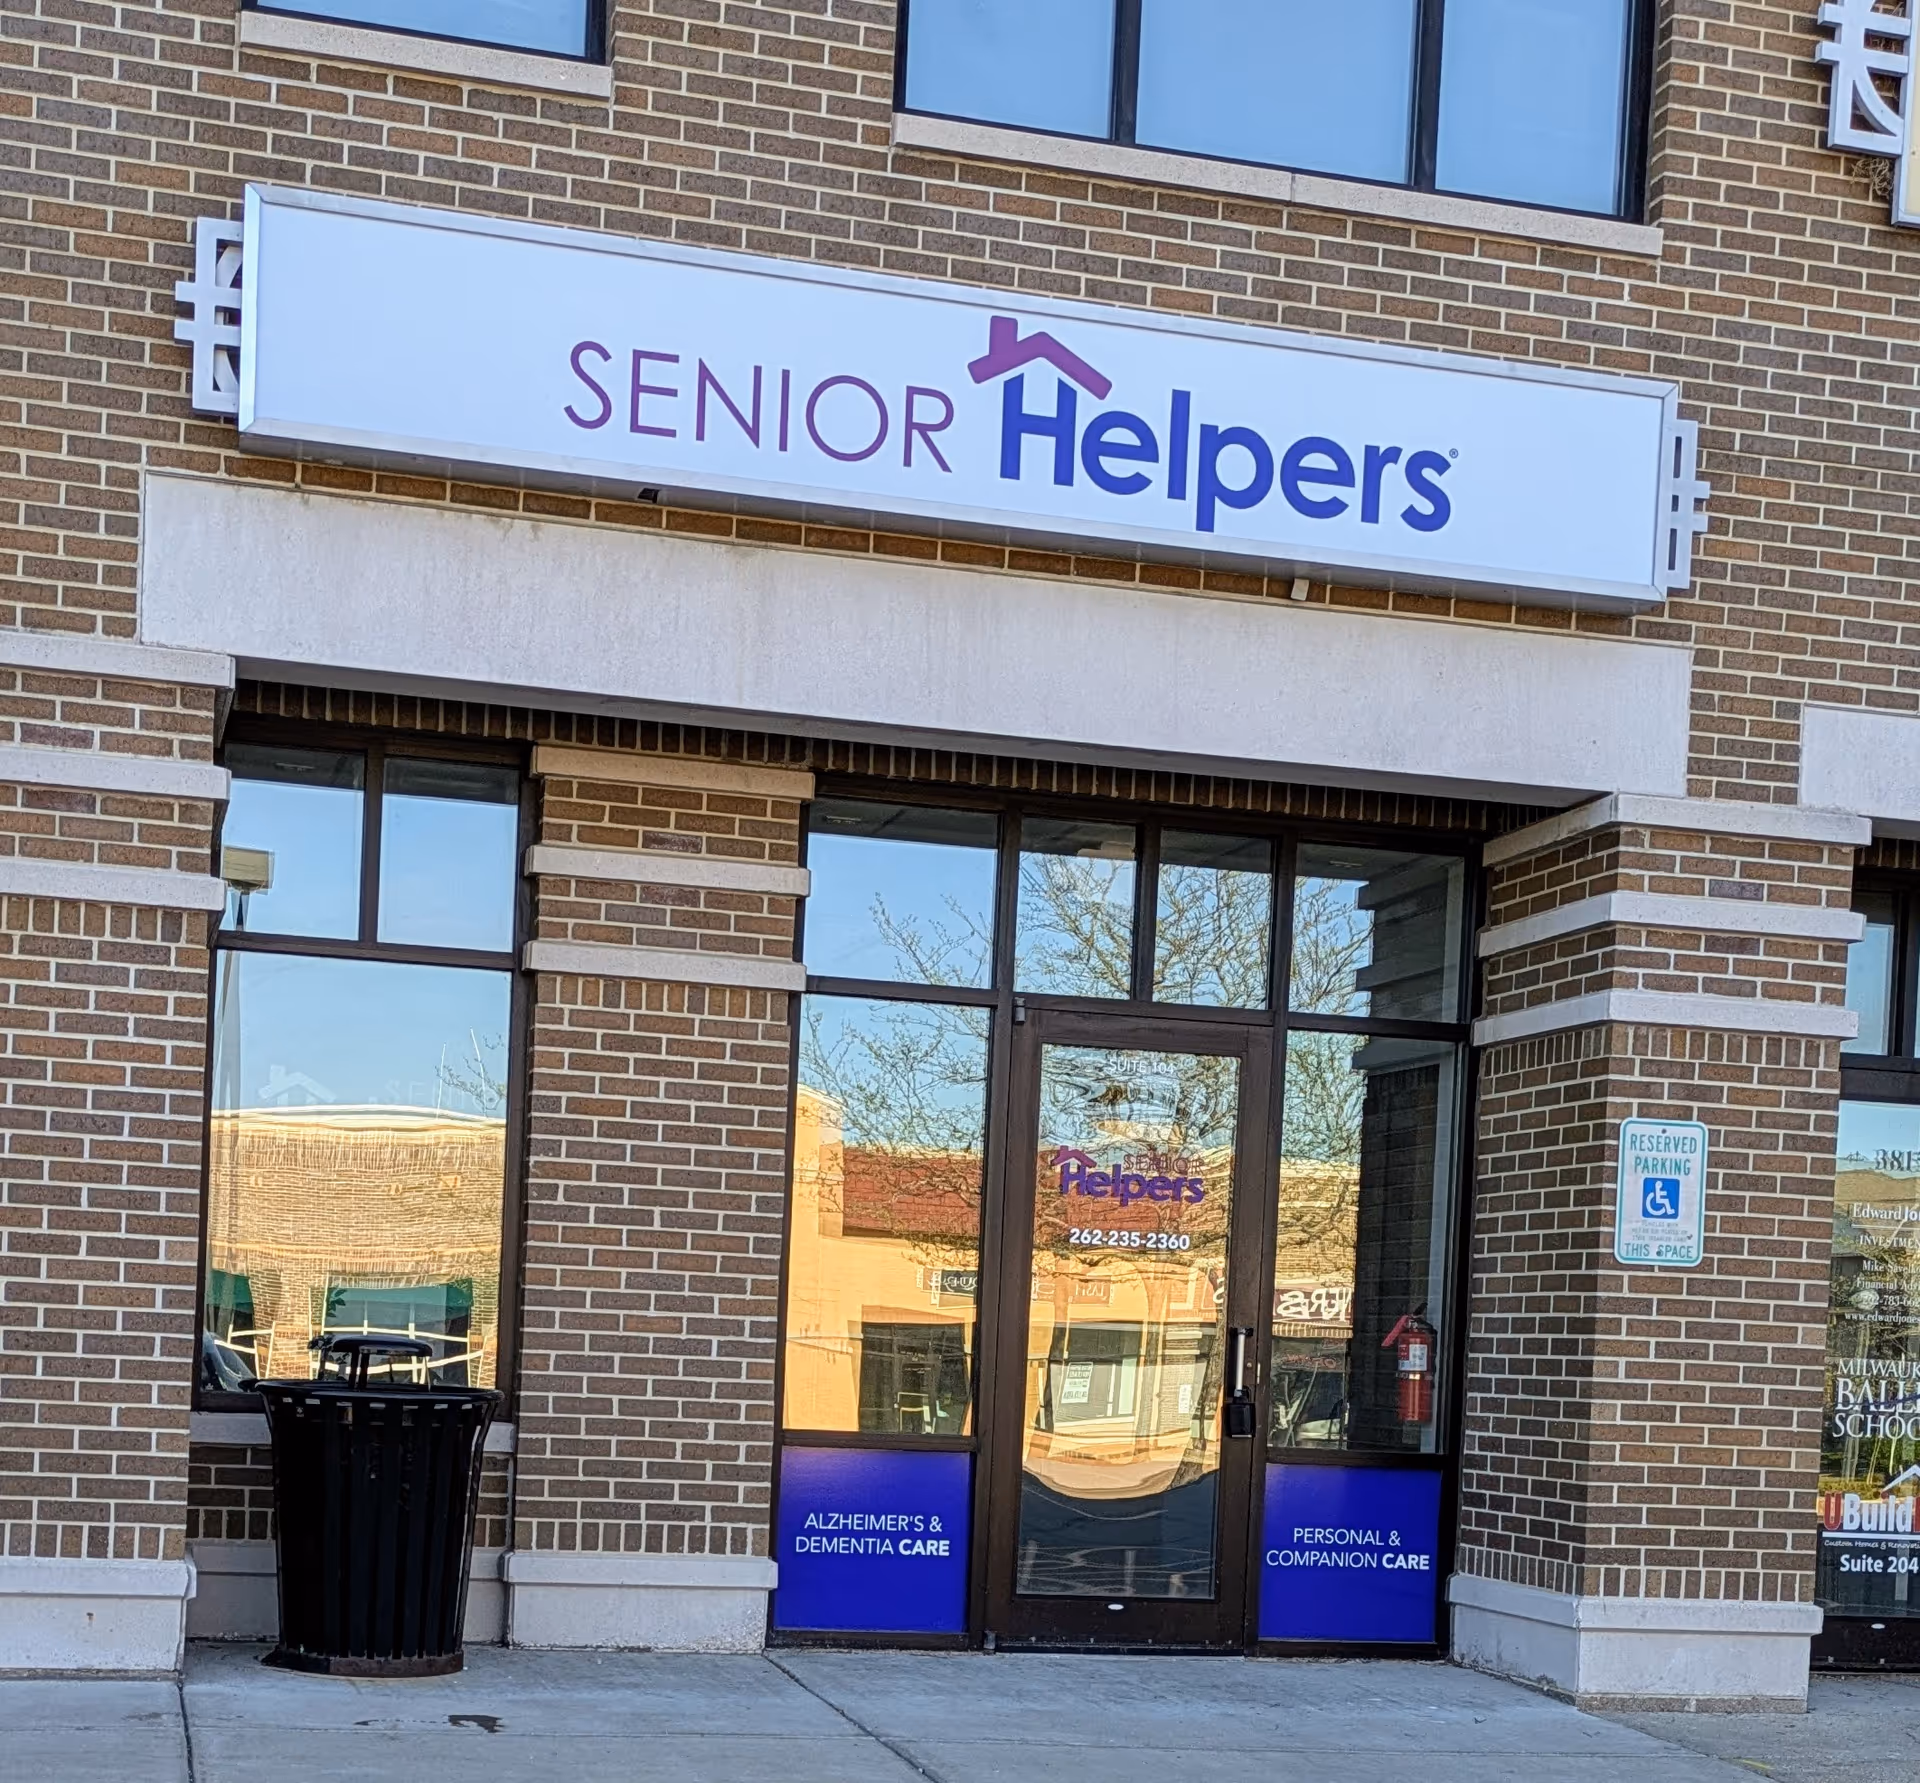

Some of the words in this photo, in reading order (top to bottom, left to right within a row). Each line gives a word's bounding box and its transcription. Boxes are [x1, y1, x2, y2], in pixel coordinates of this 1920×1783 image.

[564, 340, 954, 473] SENIOR
[1630, 1133, 1697, 1154] RESERVED
[1123, 1153, 1204, 1176] SENIOR
[1633, 1155, 1691, 1176] PARKING
[1060, 1162, 1205, 1207] Helpers
[1853, 1202, 1902, 1220] Edward
[1904, 1206, 1920, 1221] Jo
[1069, 1228, 1190, 1250] 262-235-2360
[1624, 1243, 1650, 1257] THIS
[1656, 1244, 1694, 1259] SPACE
[1862, 1259, 1884, 1272] Mike
[1837, 1357, 1920, 1379] MILWAUK
[804, 1513, 924, 1532] ALZHEIMER'S
[929, 1515, 943, 1532] &
[795, 1536, 894, 1555] DEMENTIA
[899, 1539, 950, 1556] CARE
[1293, 1528, 1384, 1546] PERSONAL
[1388, 1530, 1401, 1546] &
[1824, 1539, 1852, 1547] Custom
[1854, 1540, 1878, 1548] Homes
[1266, 1550, 1377, 1568] COMPANION
[1382, 1553, 1430, 1570] CARE
[1840, 1553, 1884, 1573] Suite
[1887, 1556, 1919, 1574] 204
